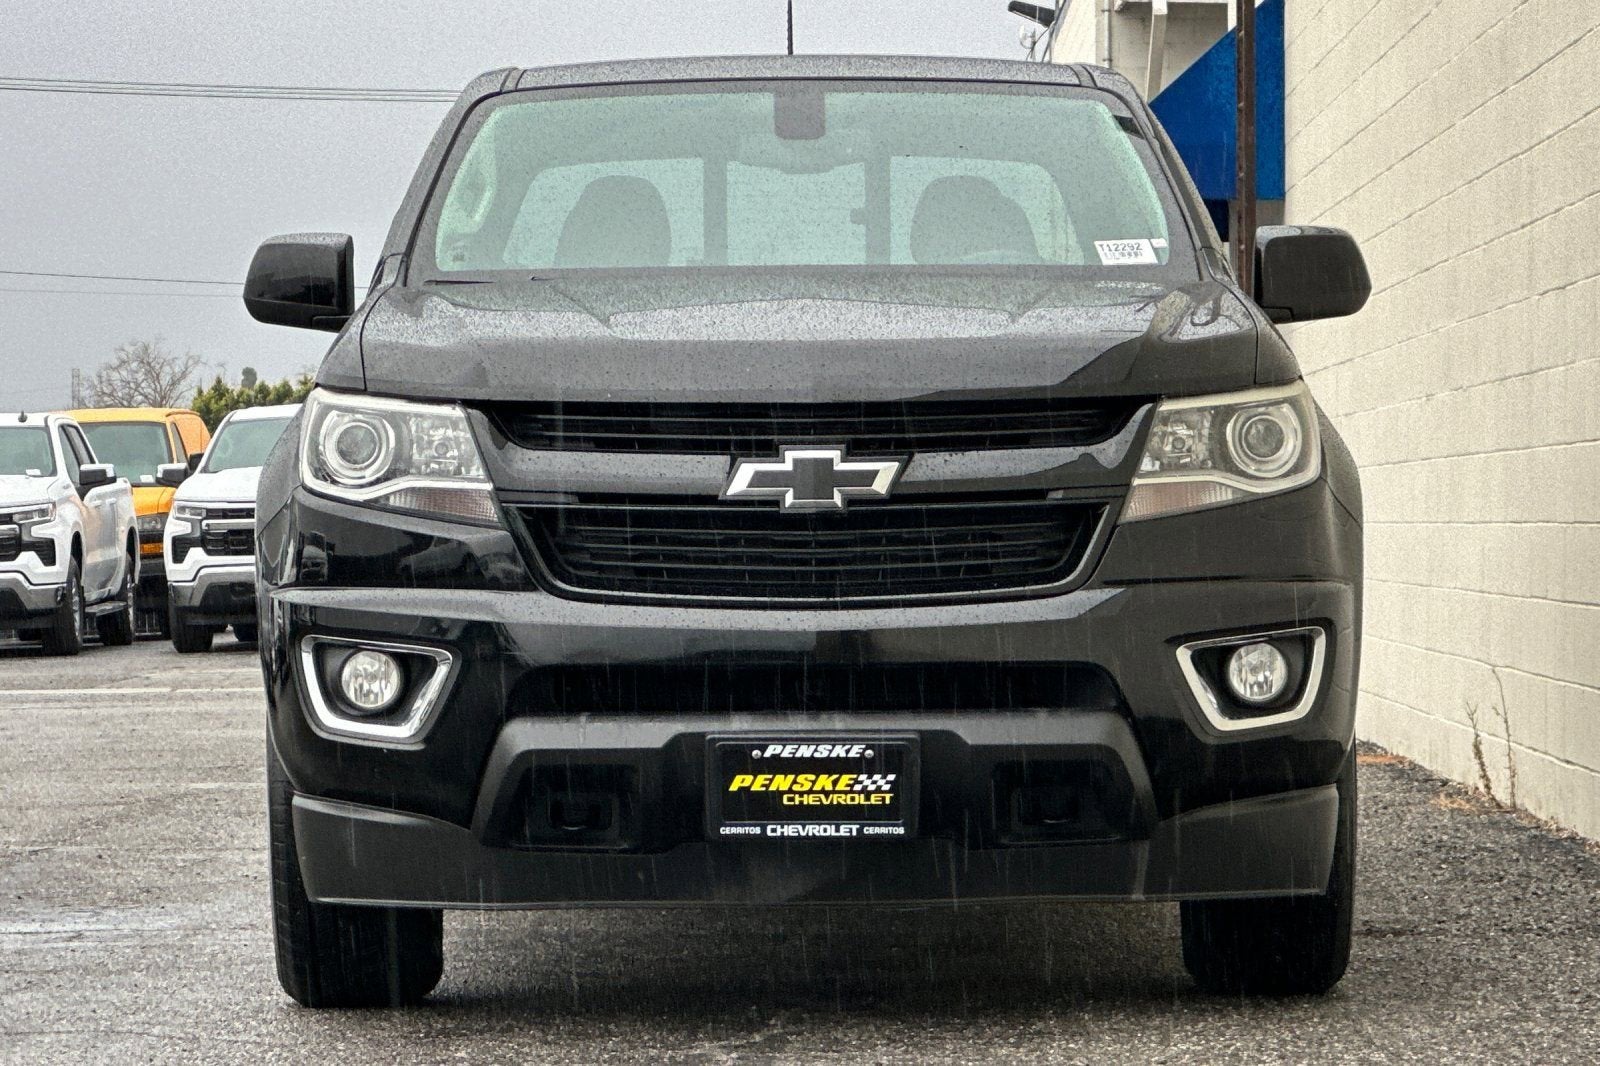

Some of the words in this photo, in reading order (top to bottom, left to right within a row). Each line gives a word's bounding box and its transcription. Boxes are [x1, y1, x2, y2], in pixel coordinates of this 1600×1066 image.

[1098, 243, 1143, 252] T12292
[763, 744, 866, 758] PENSKE
[728, 774, 858, 791] PENSKE
[783, 793, 894, 805] CHEVROLET
[720, 826, 761, 834] CERRITOS
[766, 824, 860, 836] CHEVROLET
[863, 826, 905, 834] CERRITOS
